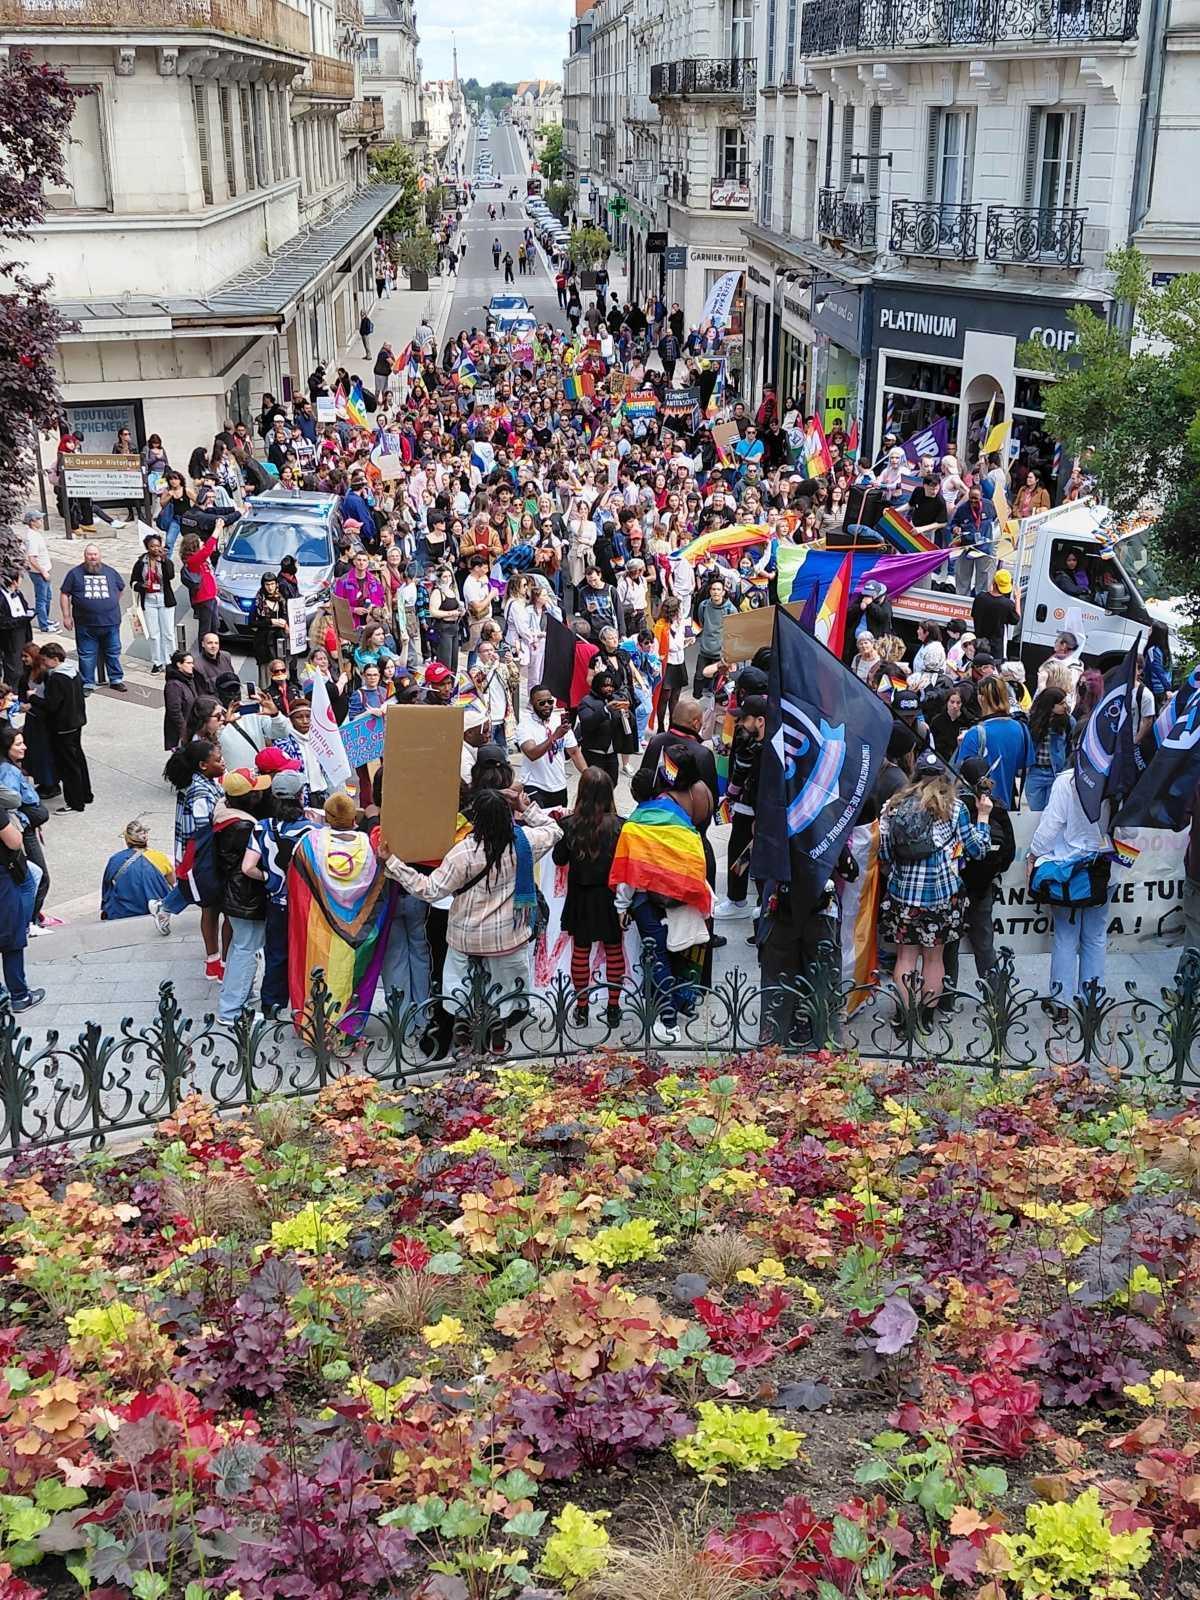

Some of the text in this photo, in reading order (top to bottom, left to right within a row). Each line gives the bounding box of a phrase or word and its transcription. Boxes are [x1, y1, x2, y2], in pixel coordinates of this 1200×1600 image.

[712, 189, 750, 206] Coiffure
[880, 308, 957, 338] PLATINIUM
[825, 397, 847, 412] LIQ
[73, 408, 129, 421] BOUTIQUE
[1118, 852, 1136, 865] cgt
[992, 916, 1055, 936] ATTO
